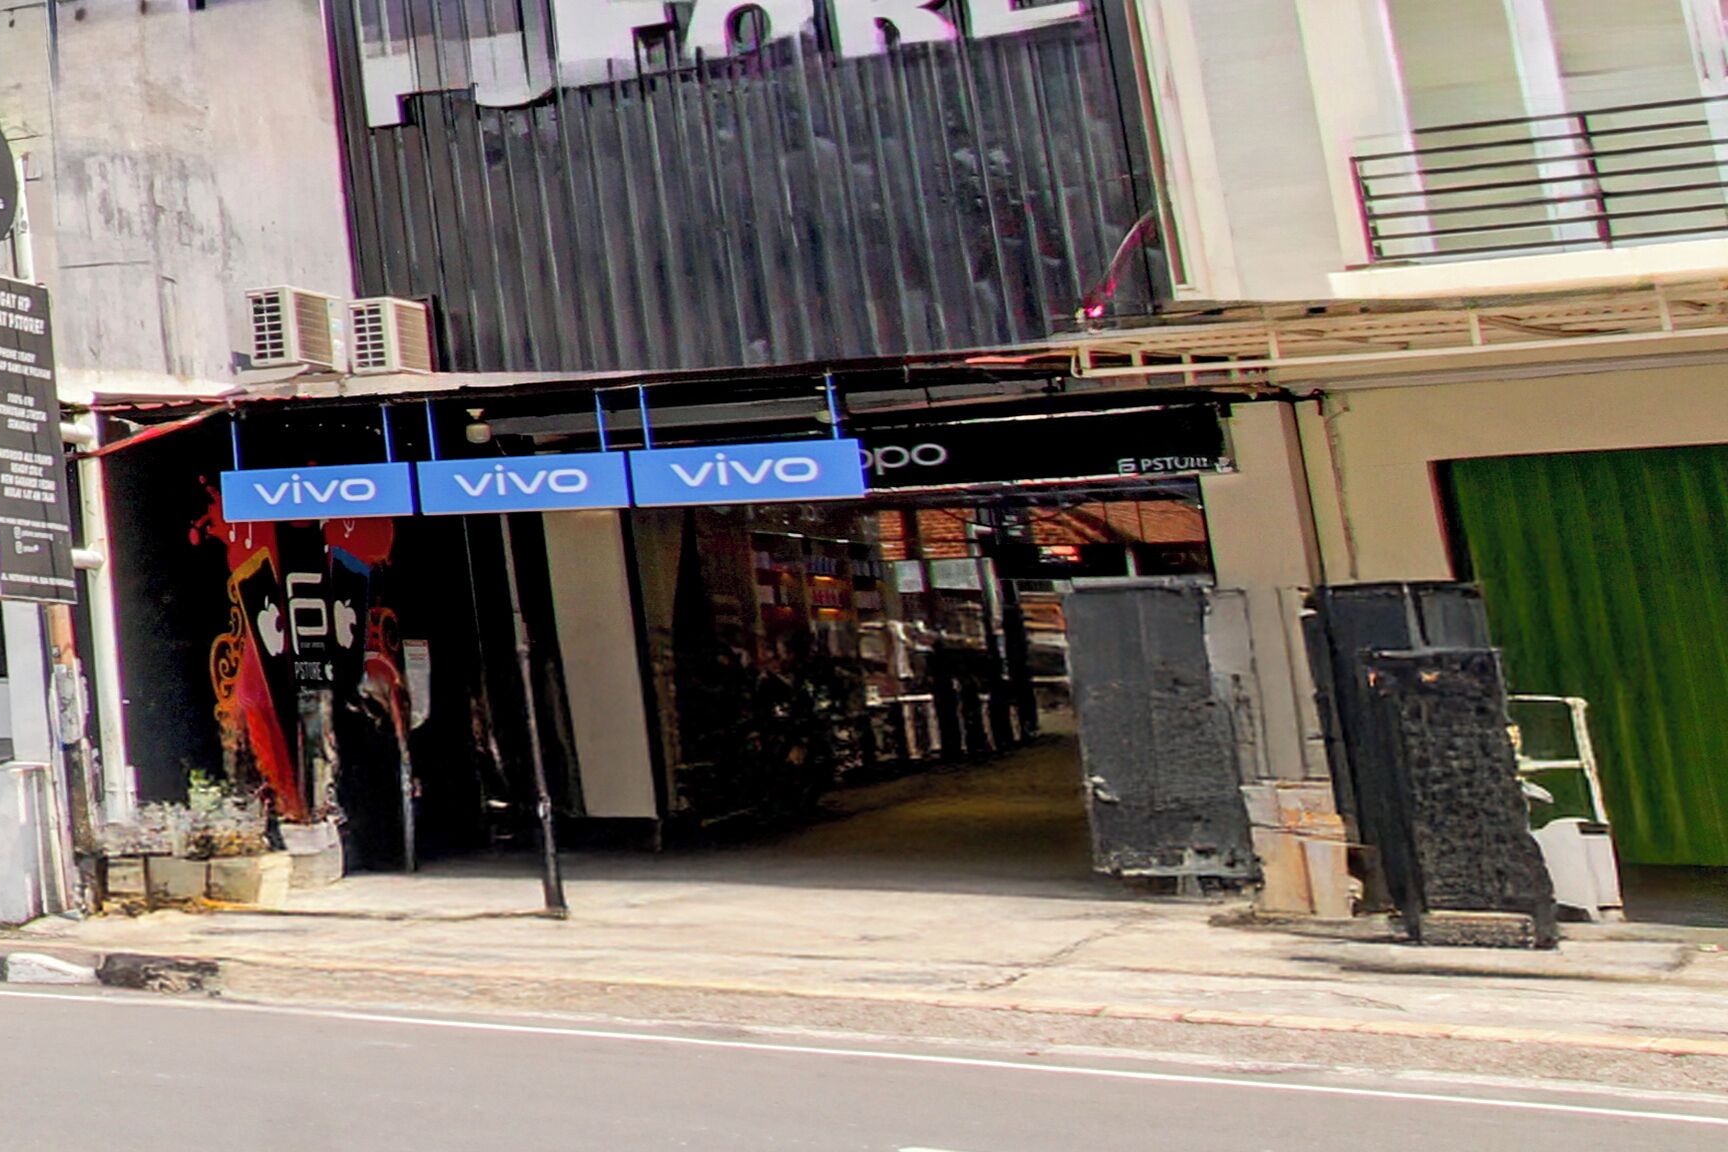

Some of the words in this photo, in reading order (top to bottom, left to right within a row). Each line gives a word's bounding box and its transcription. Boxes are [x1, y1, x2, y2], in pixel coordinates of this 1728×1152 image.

[453, 464, 588, 497] vivo
[670, 453, 820, 488] vivo
[253, 473, 376, 505] vivo
